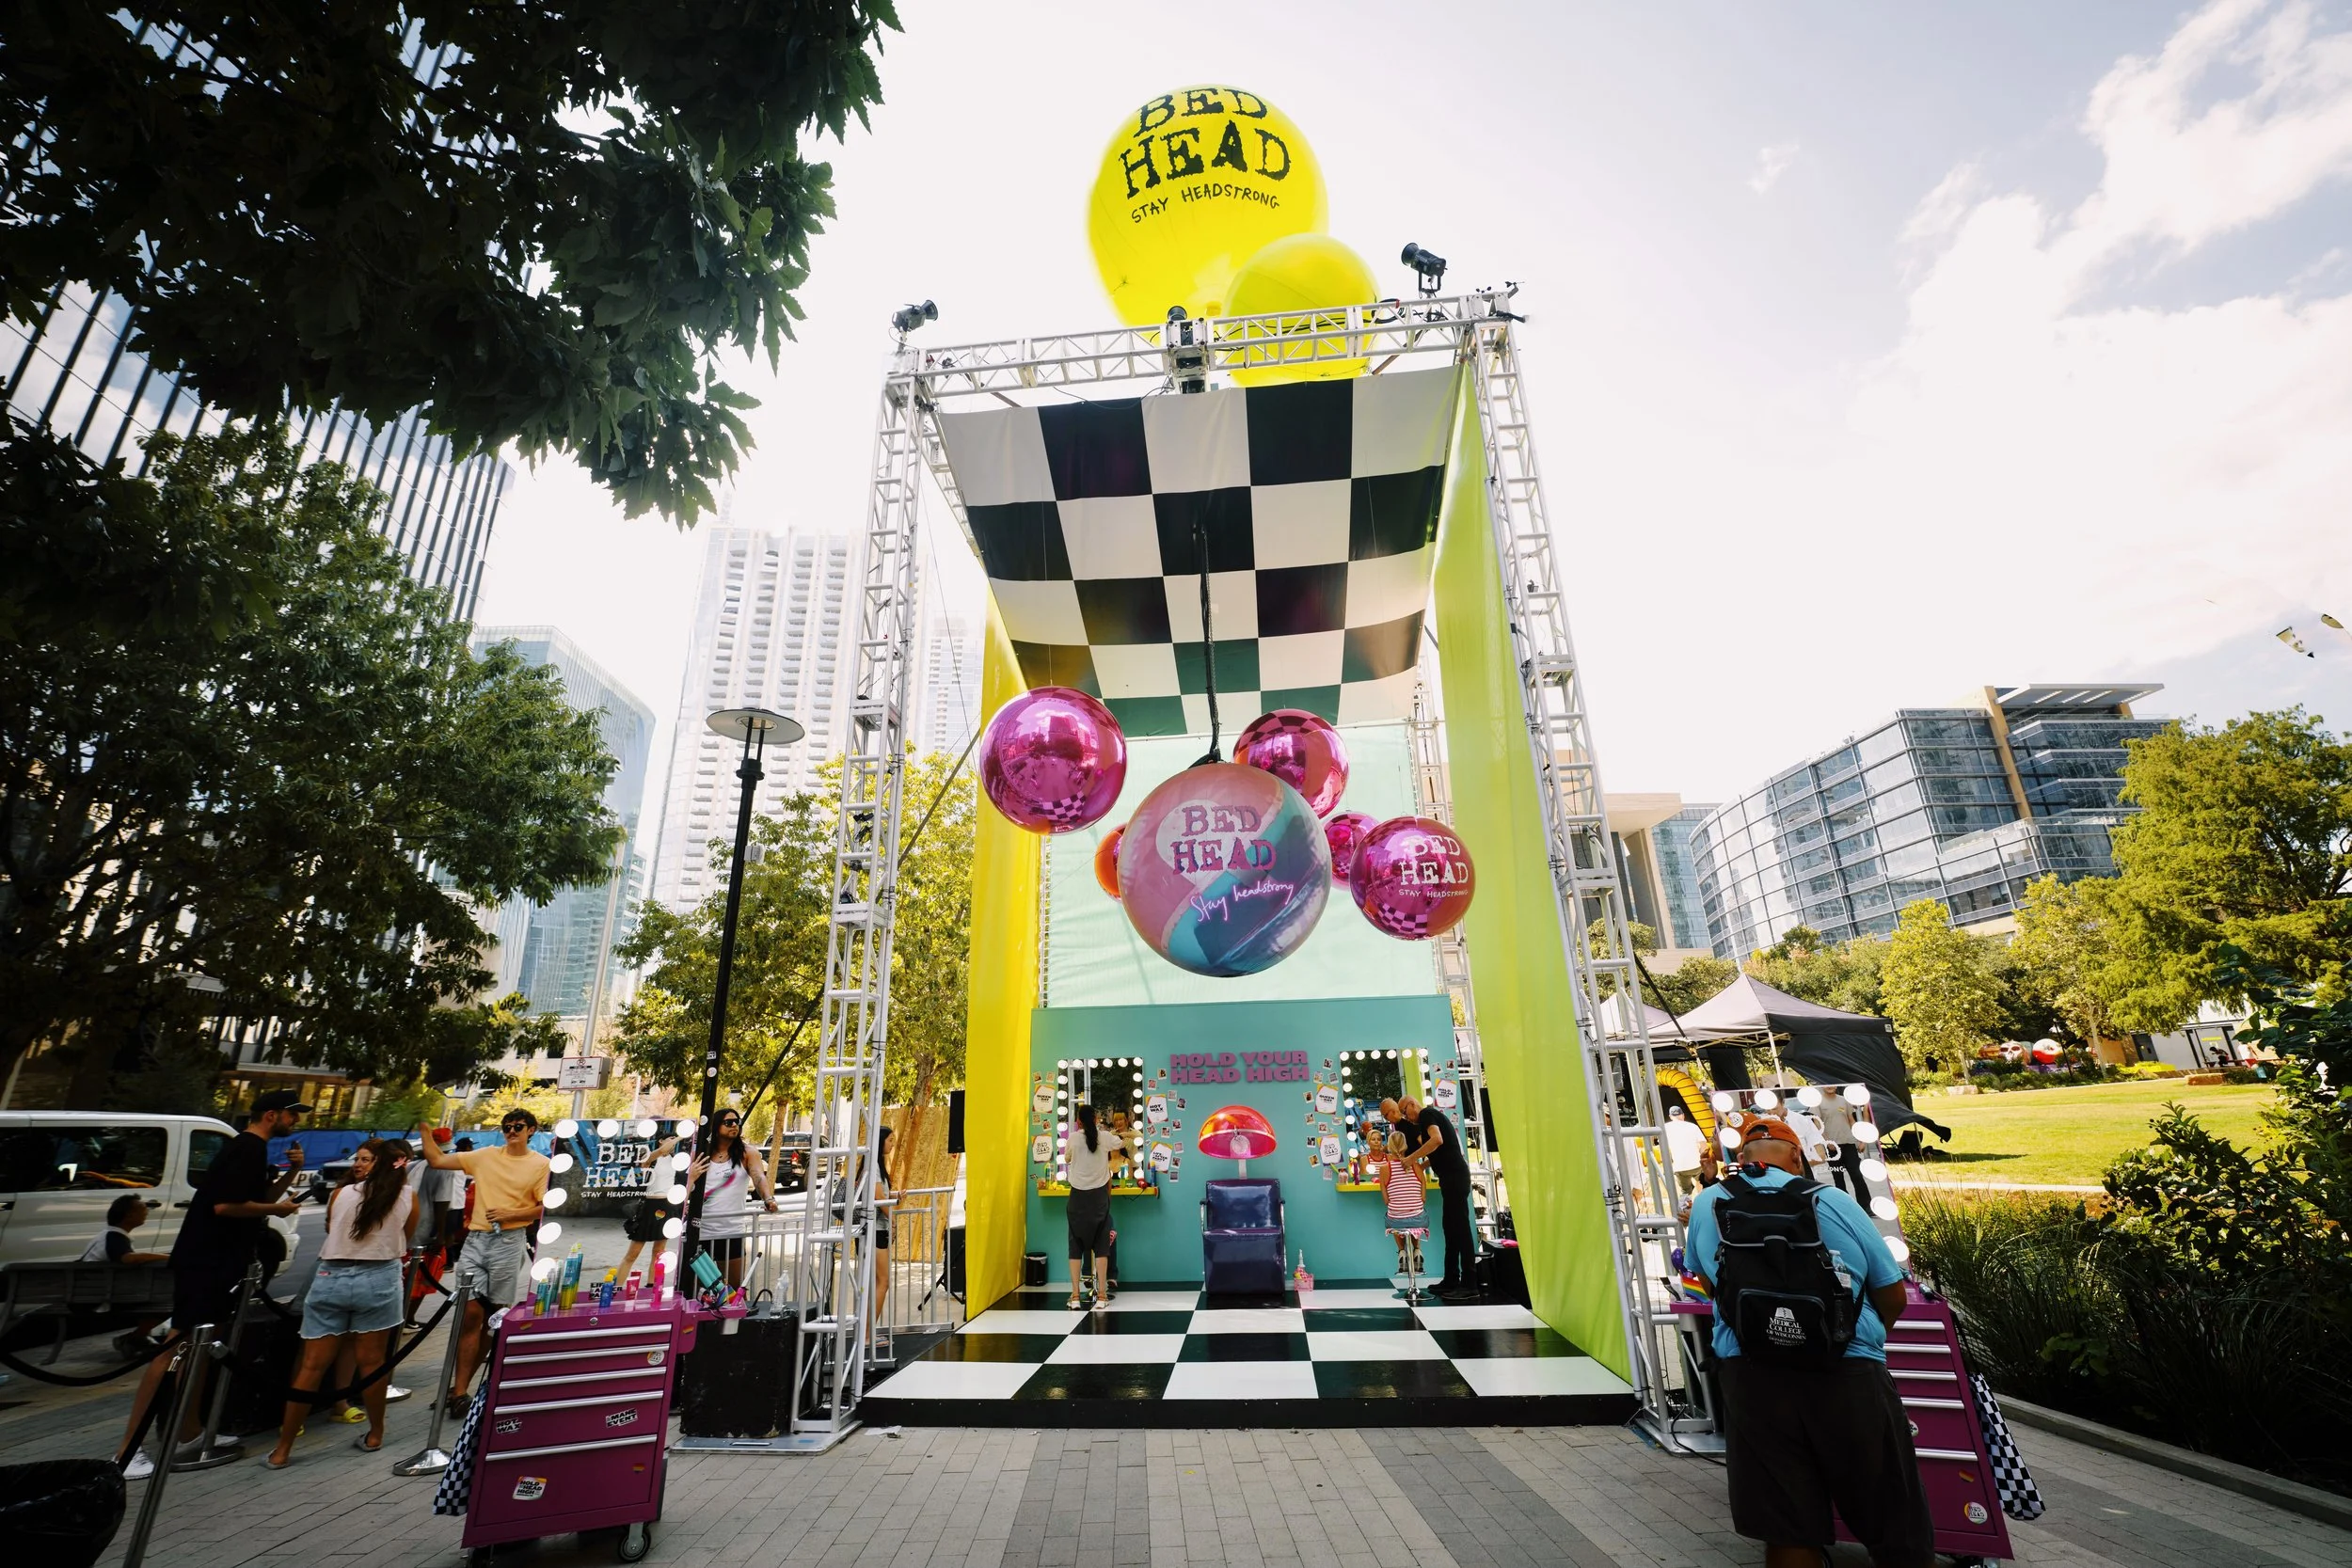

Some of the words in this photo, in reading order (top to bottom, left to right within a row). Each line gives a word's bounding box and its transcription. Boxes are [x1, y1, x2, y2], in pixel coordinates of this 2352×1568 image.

[1133, 87, 1268, 138] BED
[1119, 119, 1292, 199] HEAD
[1131, 197, 1168, 224] STAY
[1181, 183, 1280, 209] HEADSTRONG
[1182, 804, 1262, 836] BED
[1169, 836, 1277, 875] HEAD
[1402, 834, 1461, 857] BED
[1398, 860, 1469, 886] HEAD
[1190, 895, 1229, 923] Stay
[1233, 880, 1295, 905] headstrong
[1398, 888, 1422, 896] STAY
[1426, 889, 1469, 898] HEADSTRONG
[1169, 1052, 1237, 1069] HOLD
[1240, 1050, 1309, 1067] YOUR
[1170, 1068, 1242, 1085] HEAD
[1247, 1066, 1310, 1083] HIGH
[594, 1143, 651, 1165] BED
[583, 1166, 657, 1188] HEAD
[1769, 1316, 1800, 1328] MEDICAL
[1769, 1323, 1803, 1335] COLLEGE
[1774, 1331, 1806, 1339] WISCONSIN
[497, 1418, 519, 1428] HOT
[607, 1413, 637, 1427] EVENT
[611, 1408, 637, 1420] MANE
[497, 1423, 521, 1433] WAX
